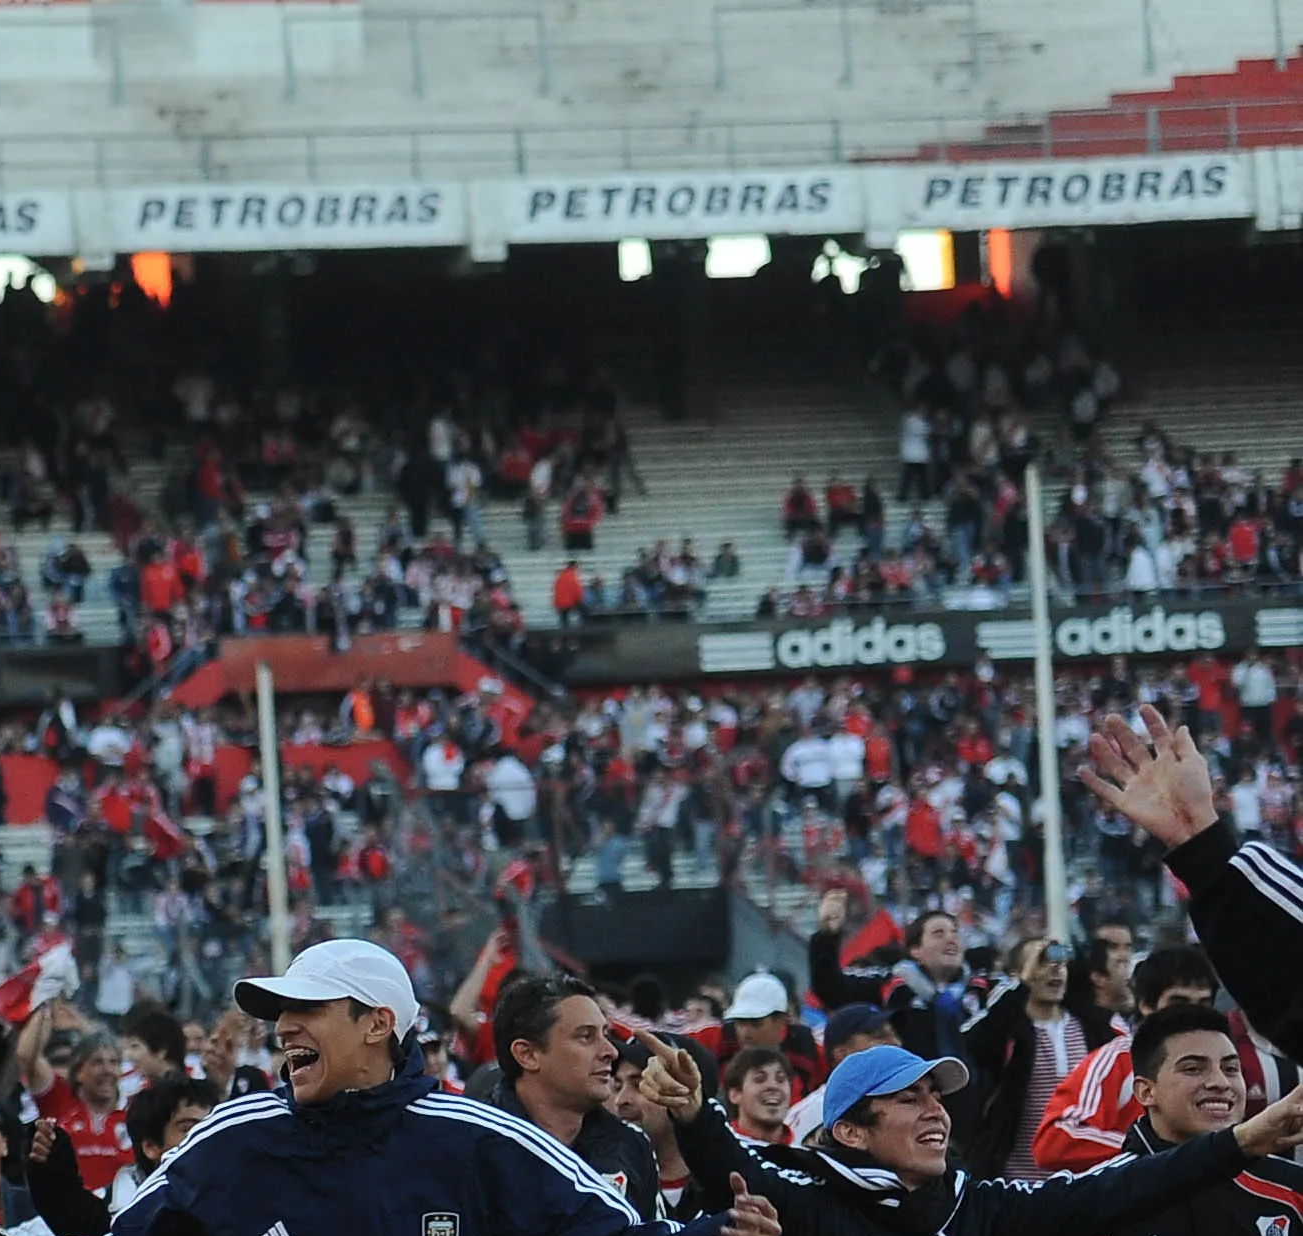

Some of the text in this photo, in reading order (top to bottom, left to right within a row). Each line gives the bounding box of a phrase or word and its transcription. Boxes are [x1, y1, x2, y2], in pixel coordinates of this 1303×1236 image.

[527, 182, 831, 221] PETROBRAS
[923, 165, 1227, 207] PETROBRAS
[138, 192, 440, 229] PETROBRAS
[777, 618, 946, 668] adidas
[1056, 606, 1226, 656] adidas
